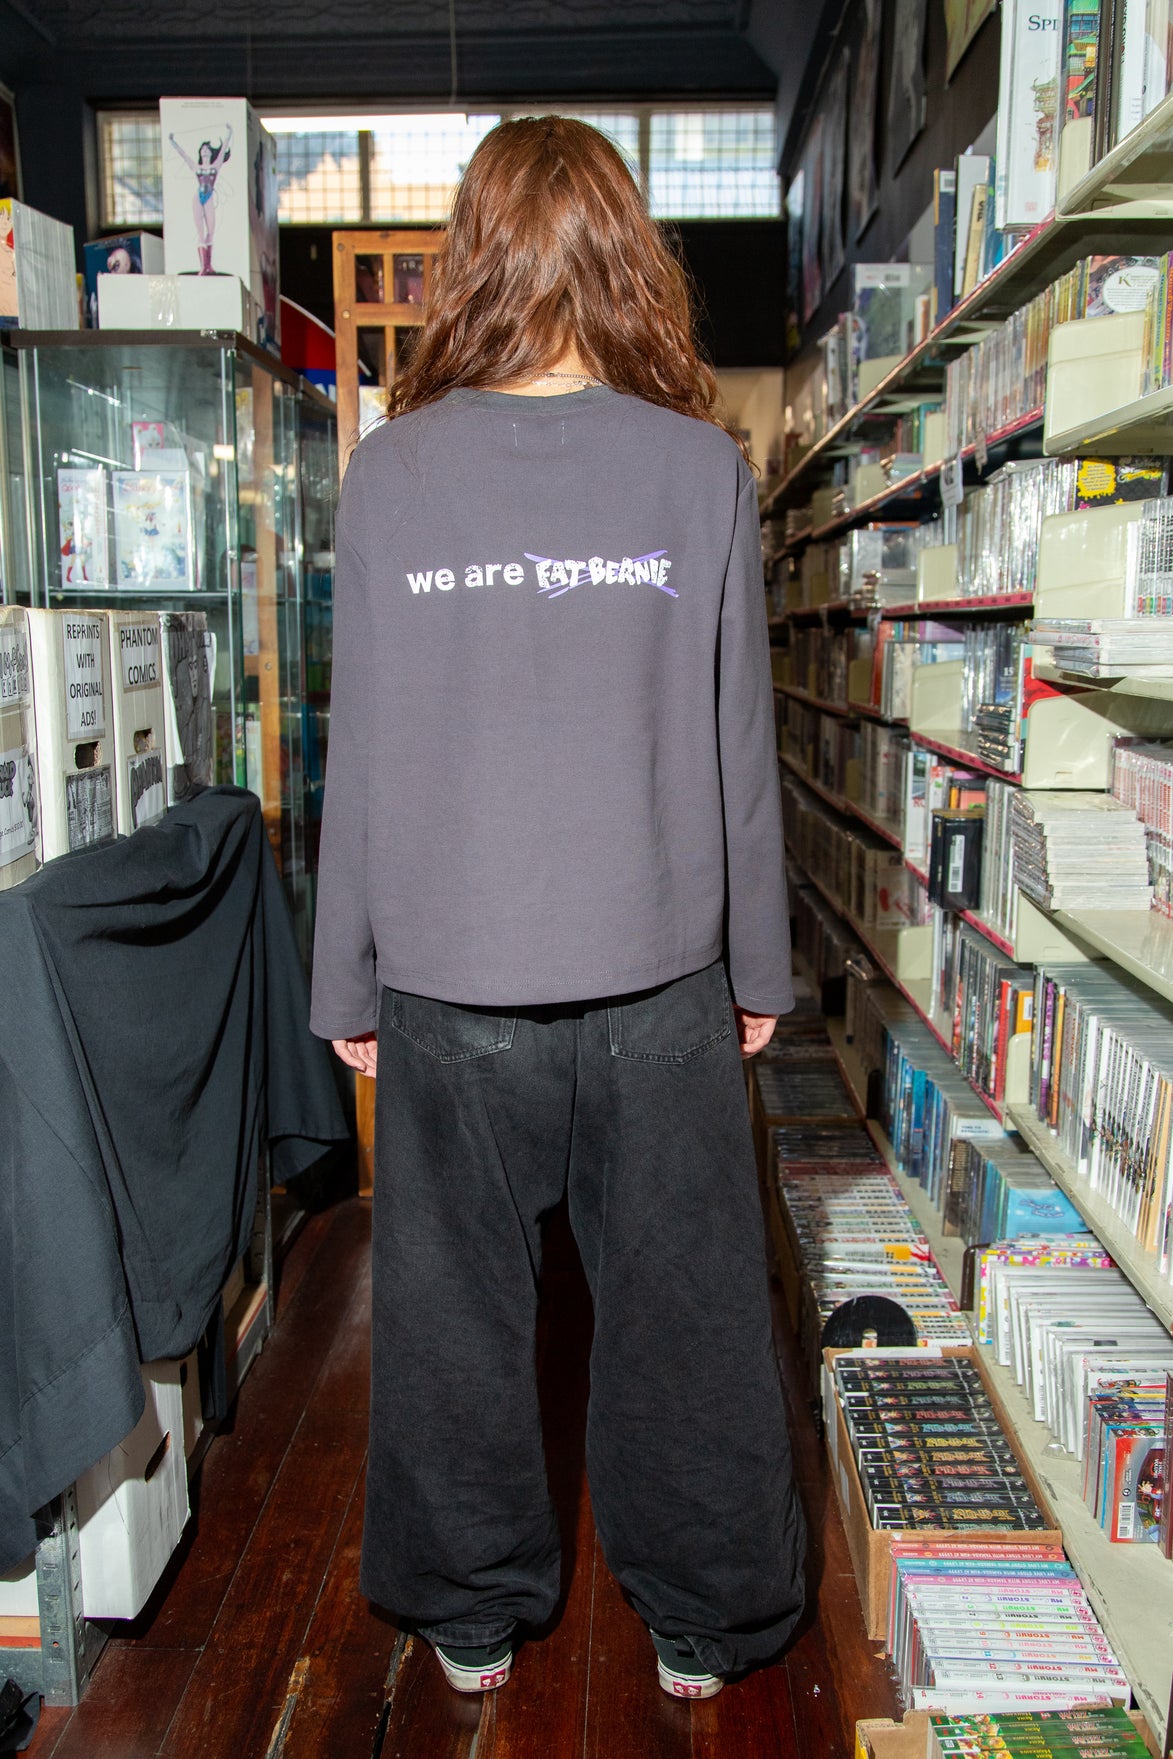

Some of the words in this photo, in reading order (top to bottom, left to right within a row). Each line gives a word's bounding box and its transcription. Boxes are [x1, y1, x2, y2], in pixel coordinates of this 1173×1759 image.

[406, 568, 455, 594] we
[464, 562, 524, 588] are
[588, 556, 672, 586] BERNIE
[66, 624, 100, 640] REPRINTS
[120, 628, 158, 648] PHANTOM
[76, 653, 95, 668] WITH
[128, 662, 156, 685] COMICS
[70, 682, 102, 698] ORIGINAL
[80, 710, 96, 727] ADS!
